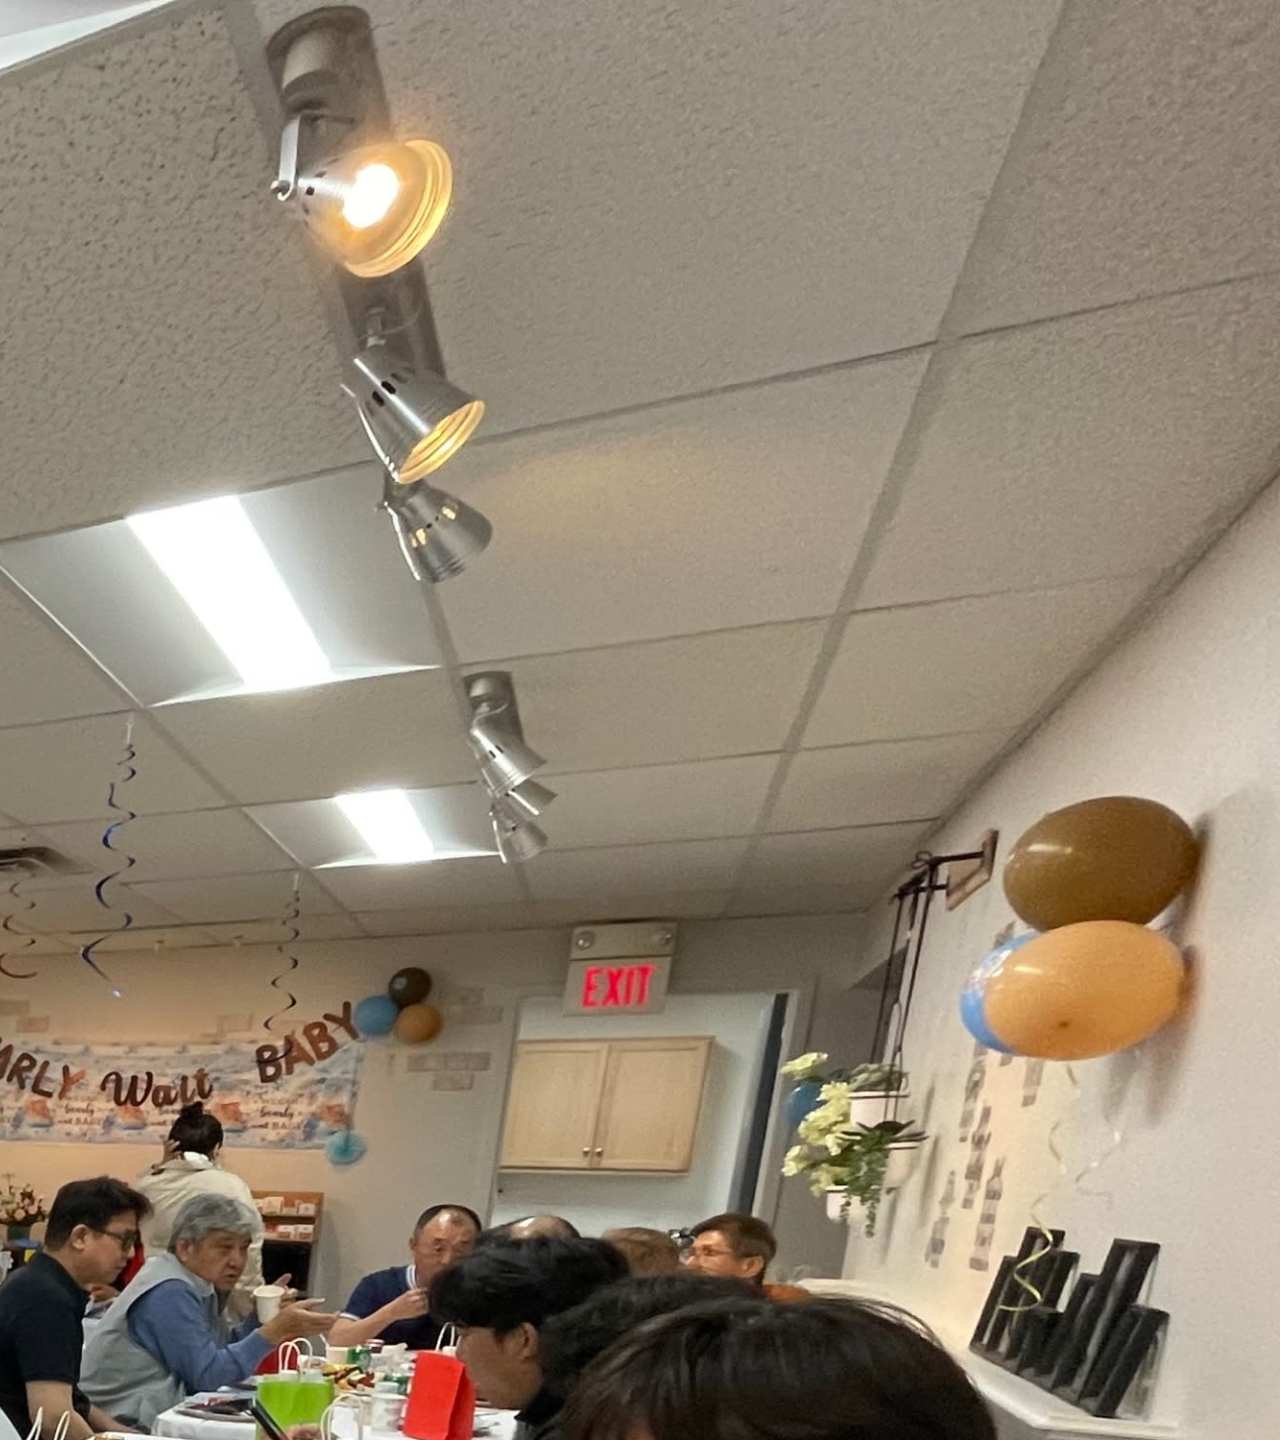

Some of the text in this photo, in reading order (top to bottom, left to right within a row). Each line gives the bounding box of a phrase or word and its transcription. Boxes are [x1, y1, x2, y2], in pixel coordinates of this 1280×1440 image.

[582, 962, 657, 1008] EXIT
[101, 1067, 213, 1108] Wait
[255, 1000, 359, 1083] BABY
